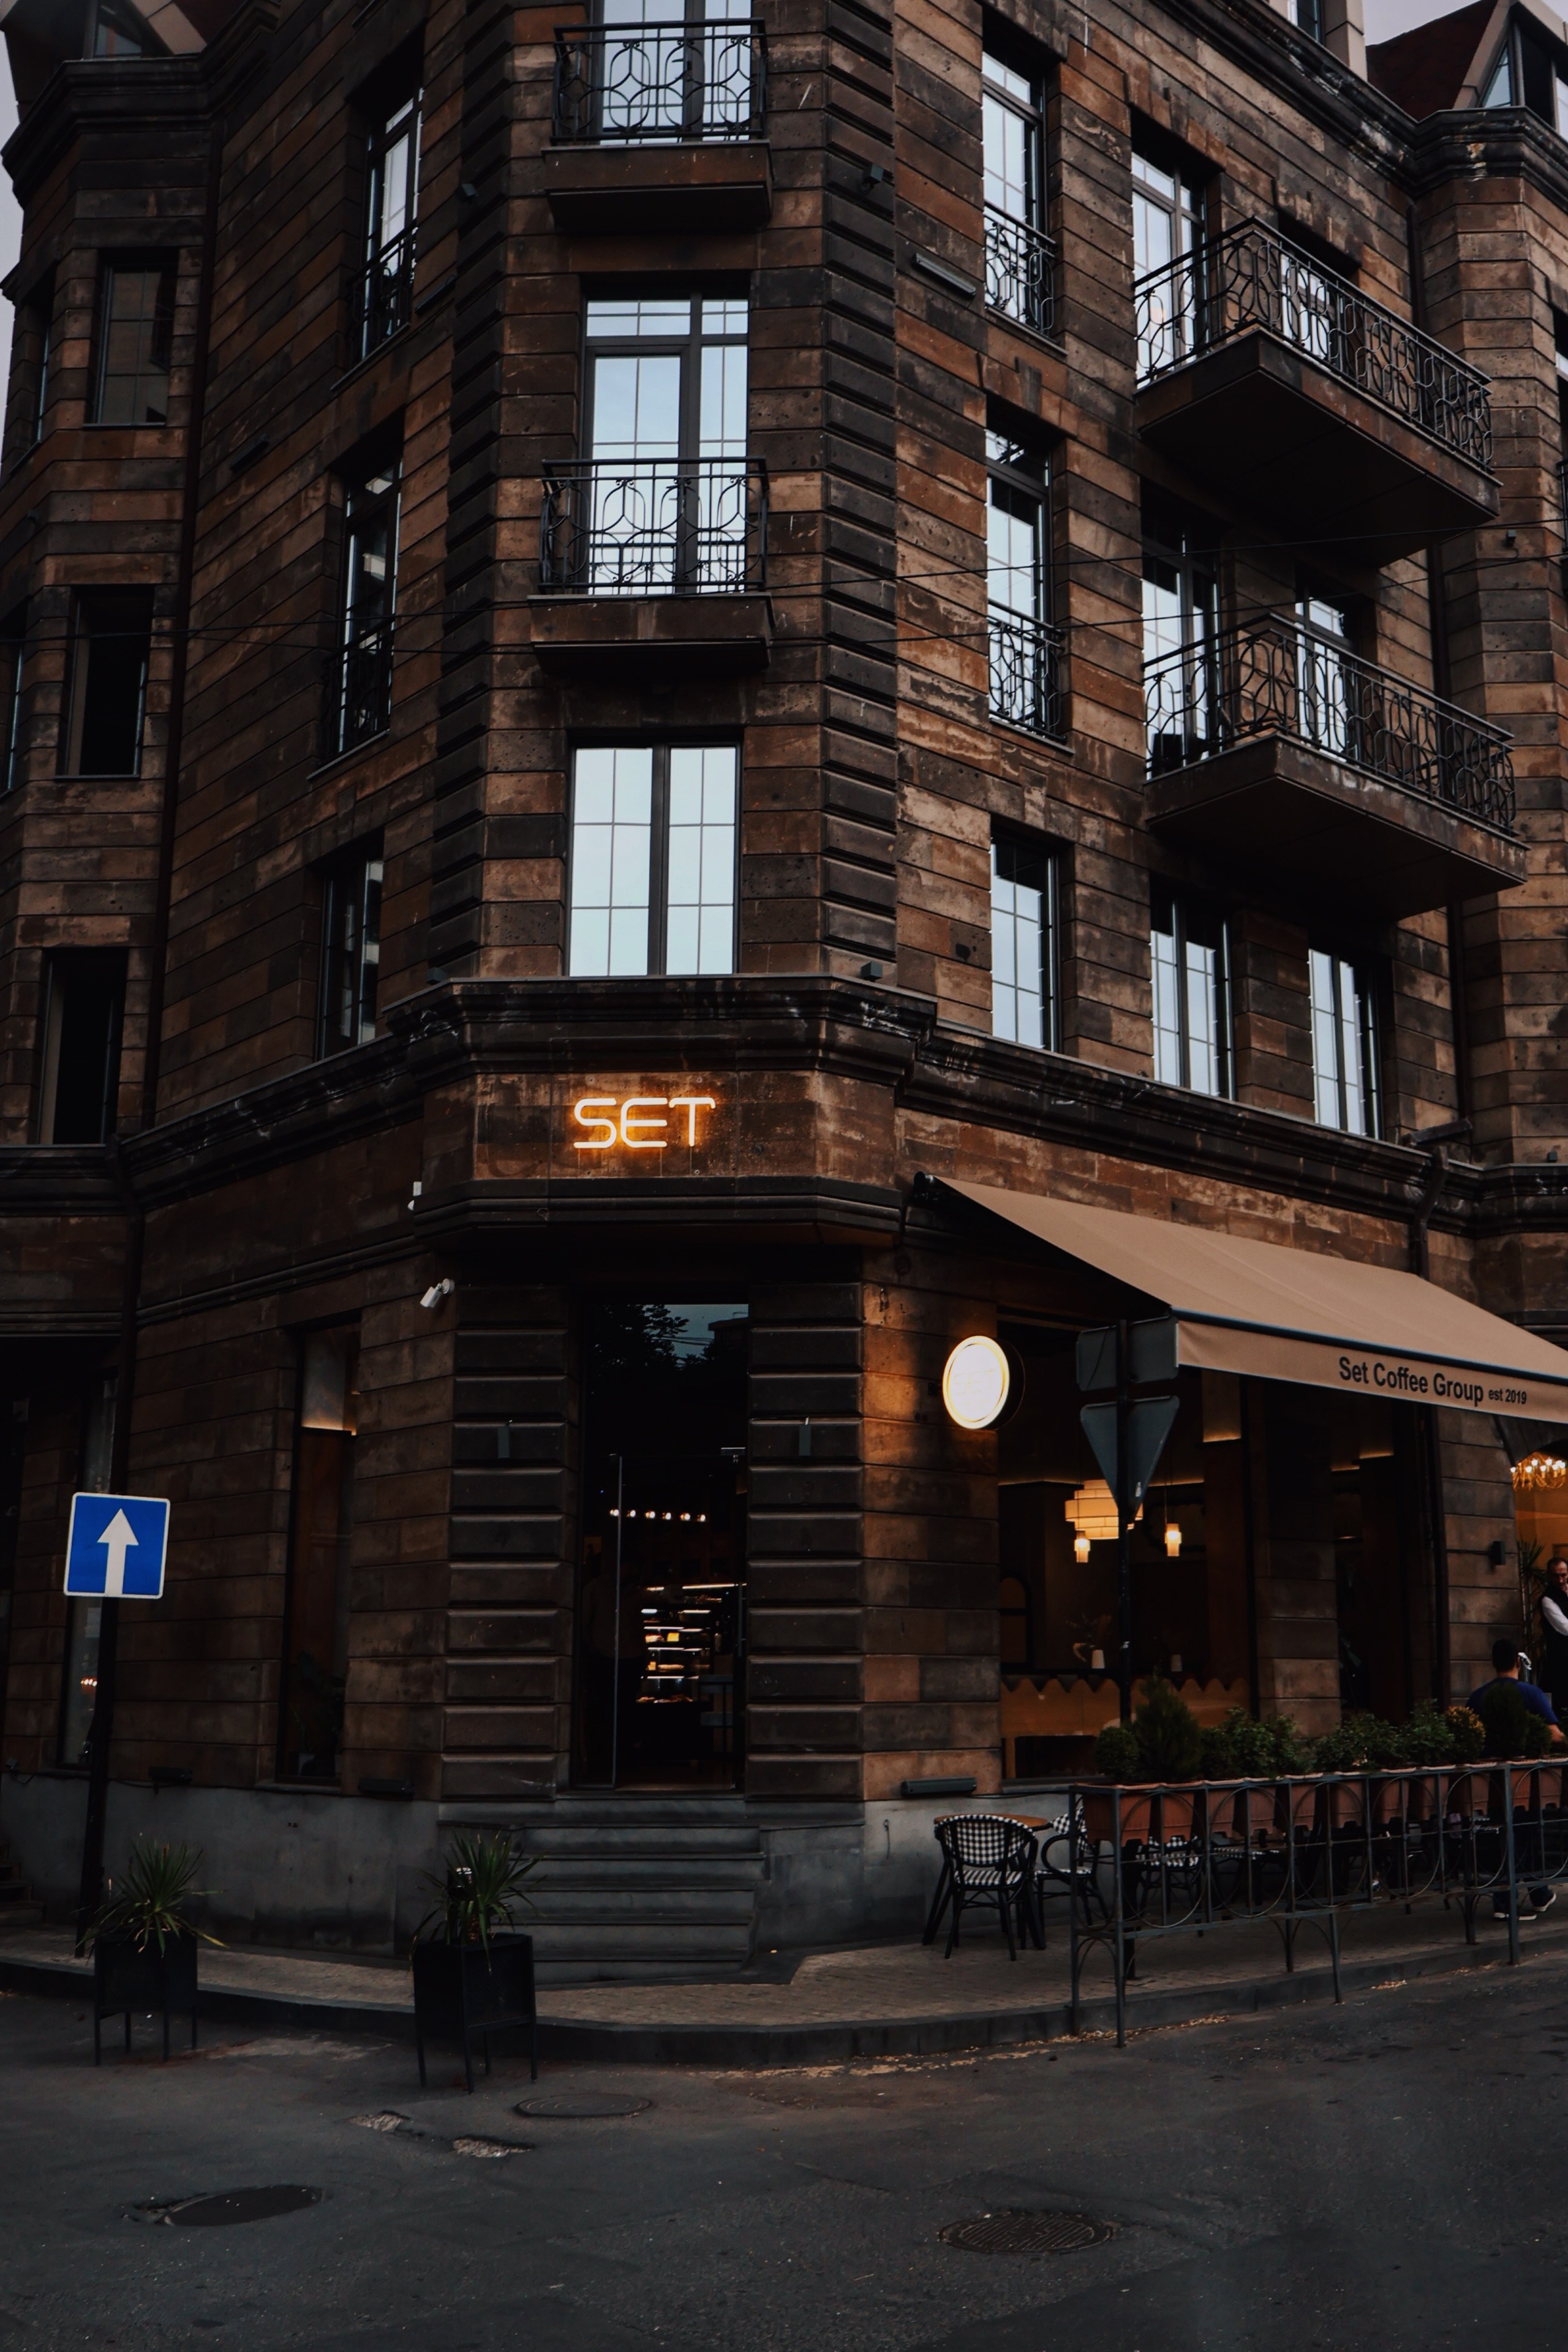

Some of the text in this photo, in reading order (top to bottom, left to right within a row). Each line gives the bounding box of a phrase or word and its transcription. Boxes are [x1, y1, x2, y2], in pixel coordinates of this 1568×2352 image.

[573, 1097, 716, 1148] SET
[1339, 1356, 1527, 1407] Set Coffee Group est 2019
